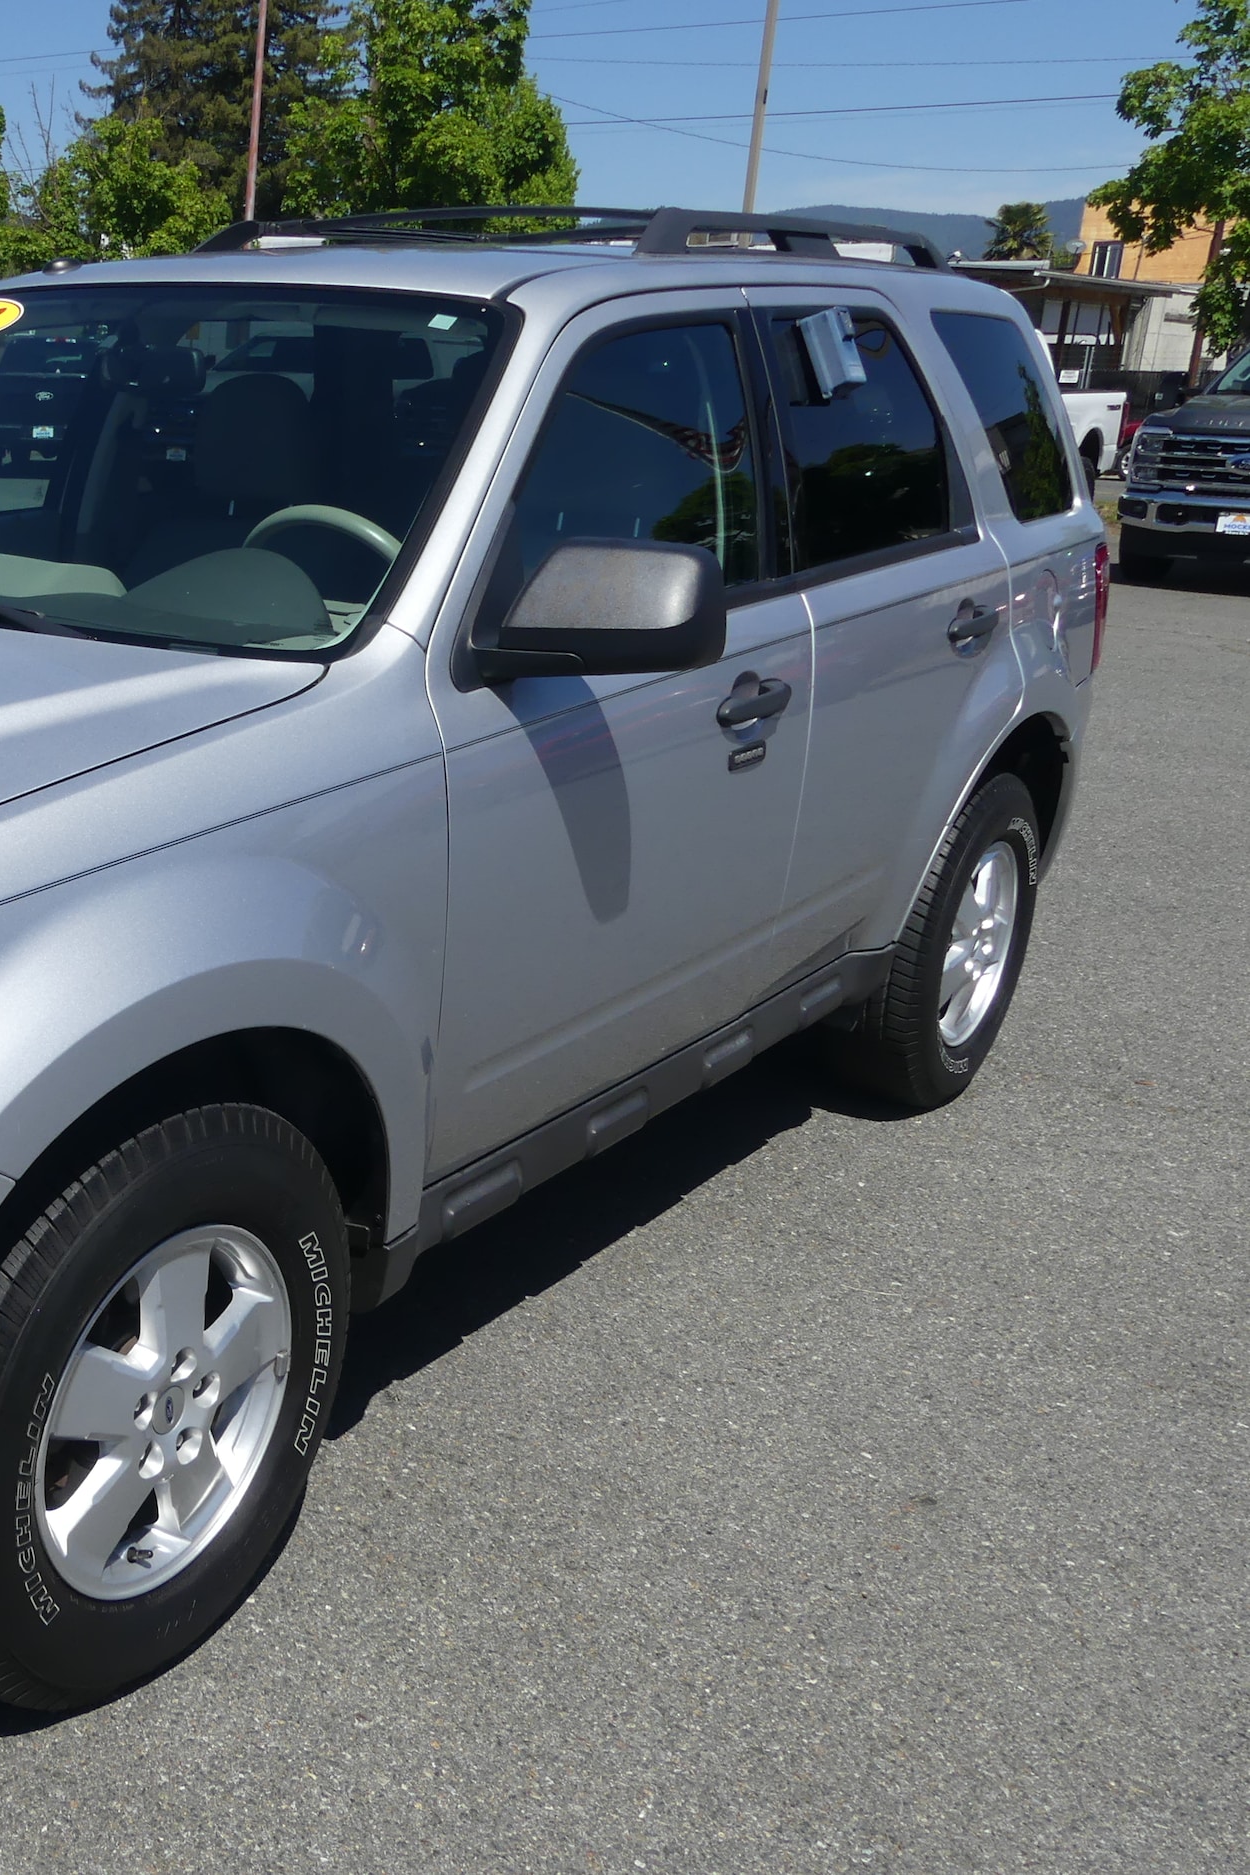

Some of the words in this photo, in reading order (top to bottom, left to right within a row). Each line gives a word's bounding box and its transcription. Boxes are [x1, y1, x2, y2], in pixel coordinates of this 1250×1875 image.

[1007, 817, 1037, 885] MICHELIN
[294, 1231, 332, 1456] MICHELIN
[16, 1373, 60, 1625] MICHELIN
